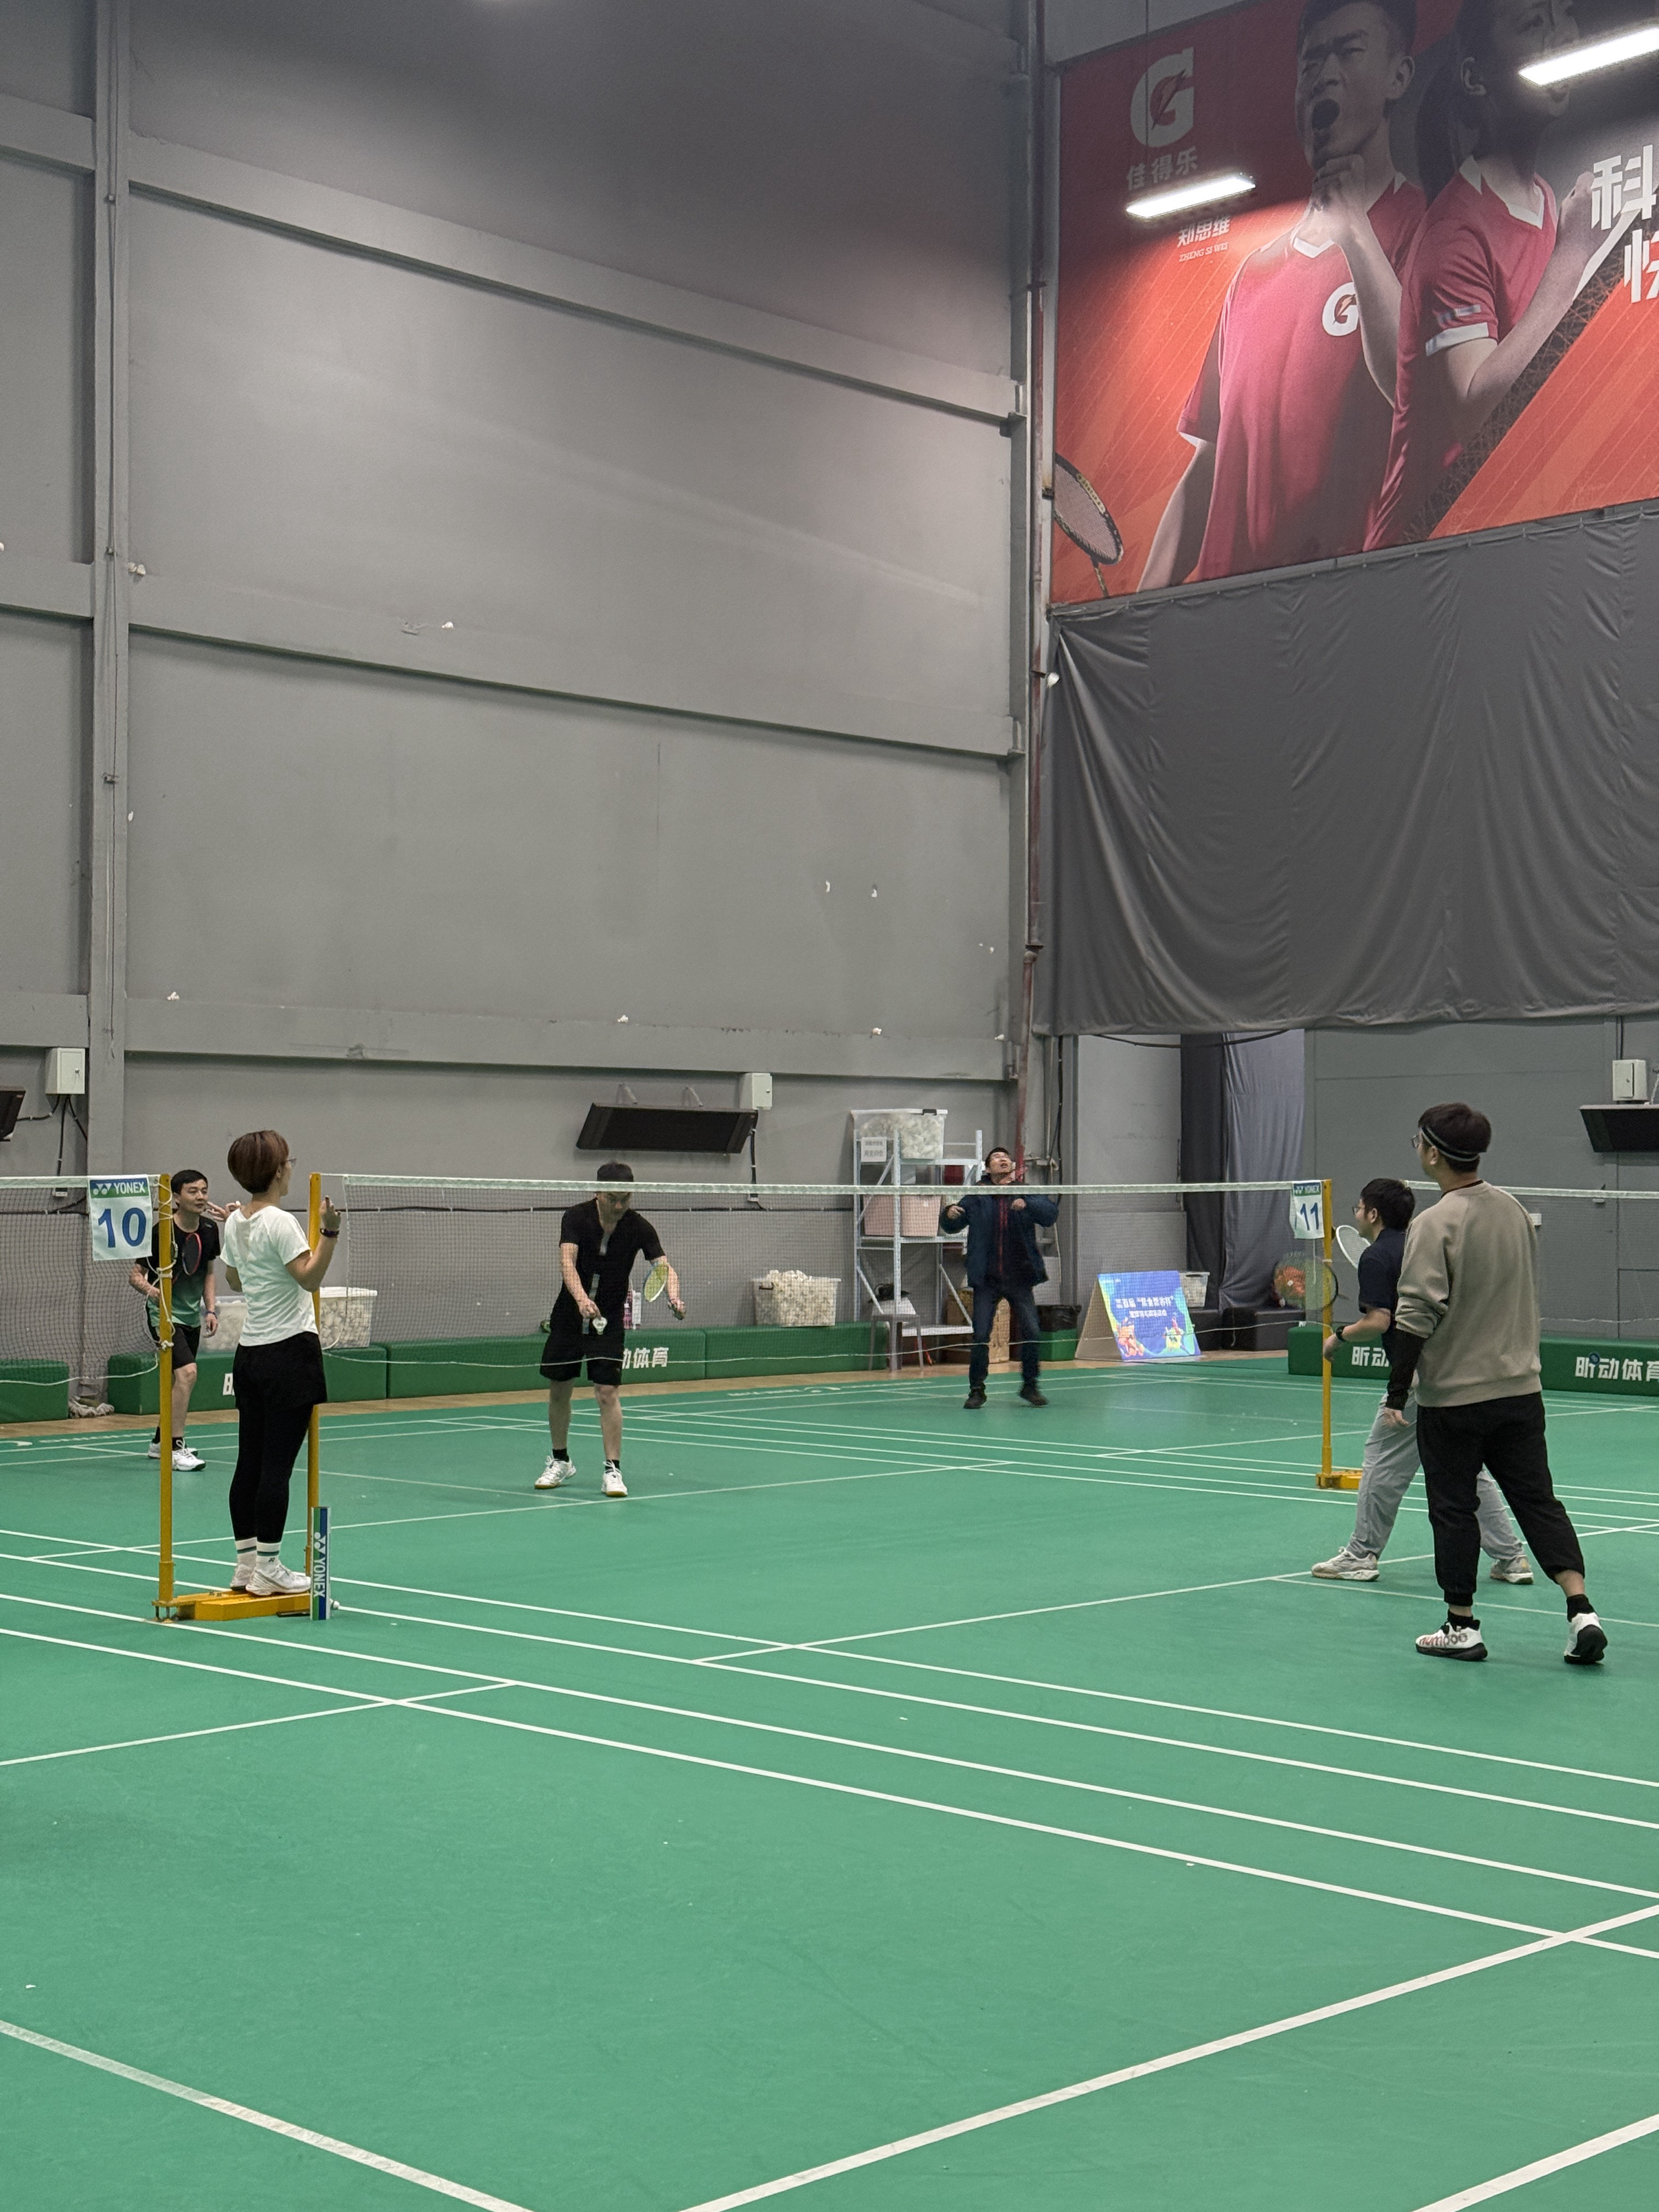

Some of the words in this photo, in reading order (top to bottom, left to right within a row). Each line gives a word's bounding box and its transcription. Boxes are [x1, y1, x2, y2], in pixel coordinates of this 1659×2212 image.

[1130, 46, 1195, 148] G
[1126, 146, 1198, 191] 佳得乐
[1177, 215, 1231, 248] 郑思维
[1178, 249, 1205, 262] ZHENG
[1205, 246, 1214, 255] SI
[1214, 242, 1229, 252] WEI
[114, 1181, 146, 1194] YONEX
[98, 1207, 146, 1248] 10
[1300, 1203, 1319, 1231] 11
[313, 1556, 326, 1598] YONEX
